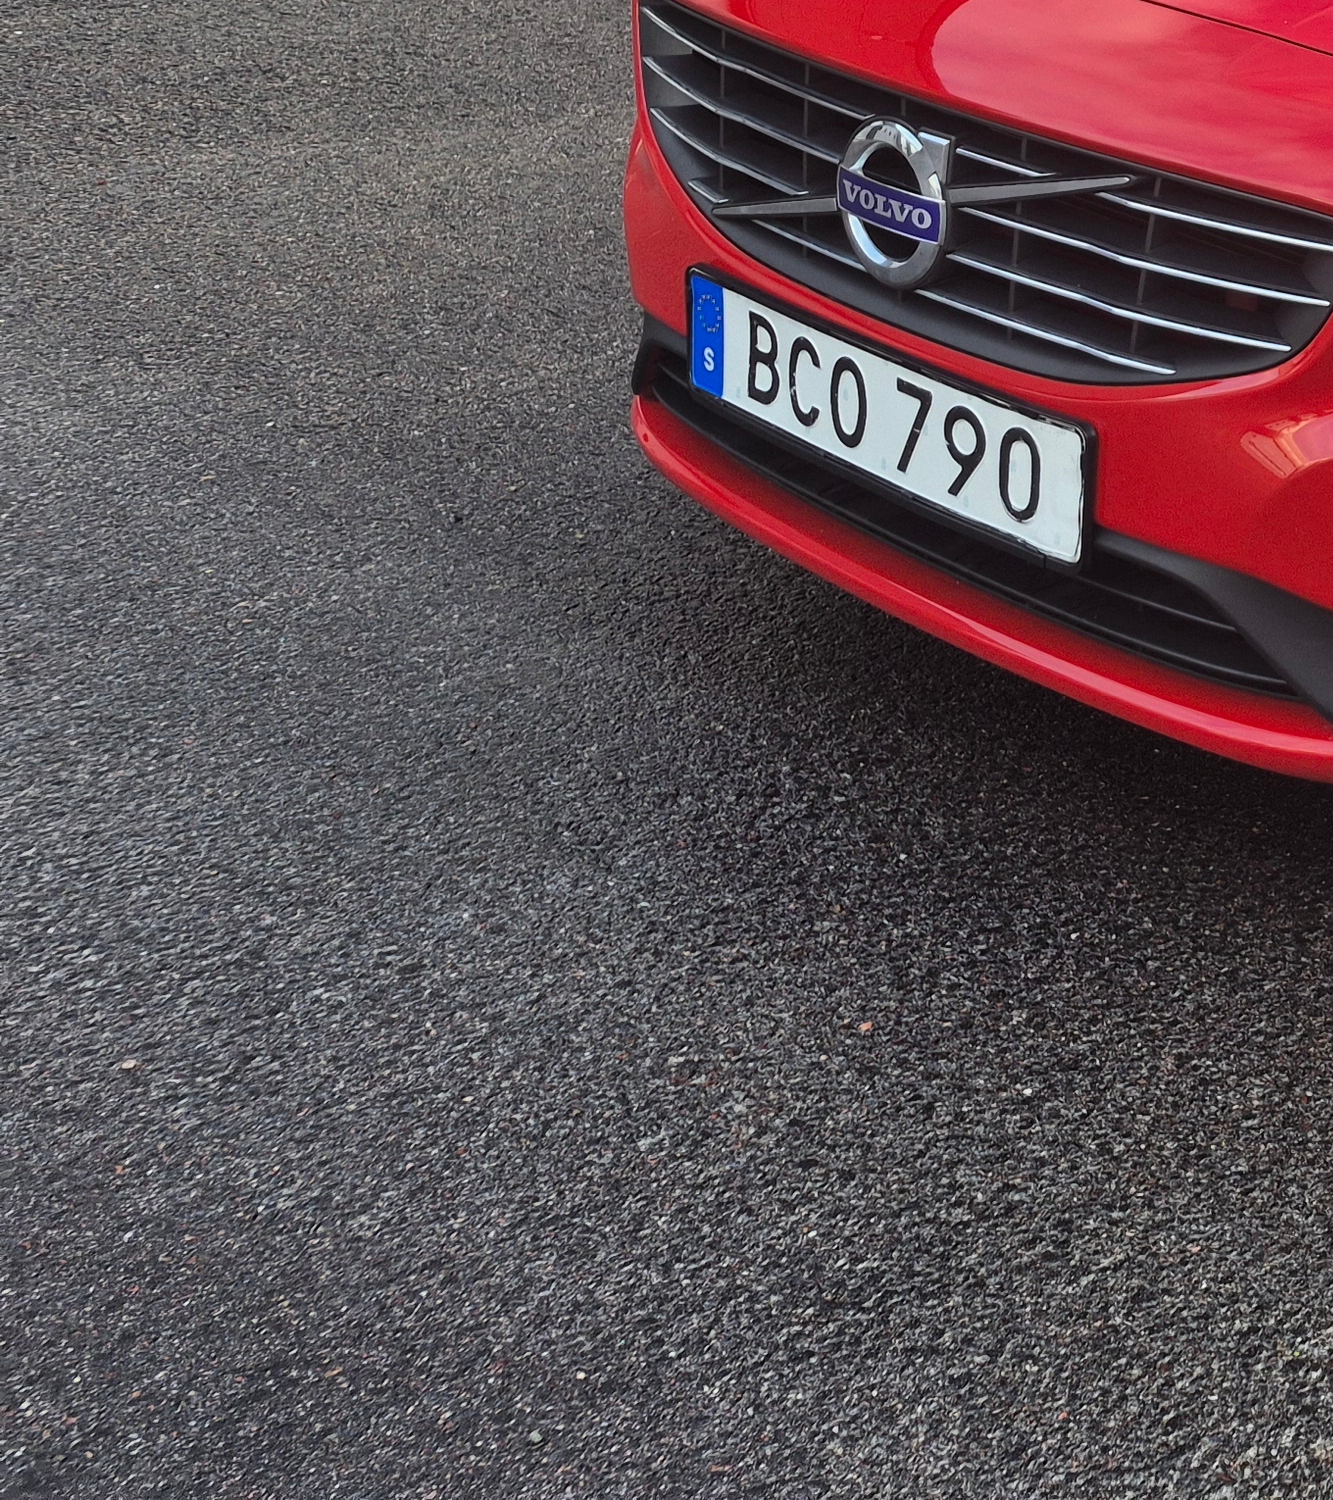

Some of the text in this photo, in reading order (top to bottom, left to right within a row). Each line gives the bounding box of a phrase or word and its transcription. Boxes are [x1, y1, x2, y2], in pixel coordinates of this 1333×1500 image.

[842, 178, 932, 230] VOLVO
[703, 346, 716, 373] S
[746, 309, 1041, 524] BCO 790
